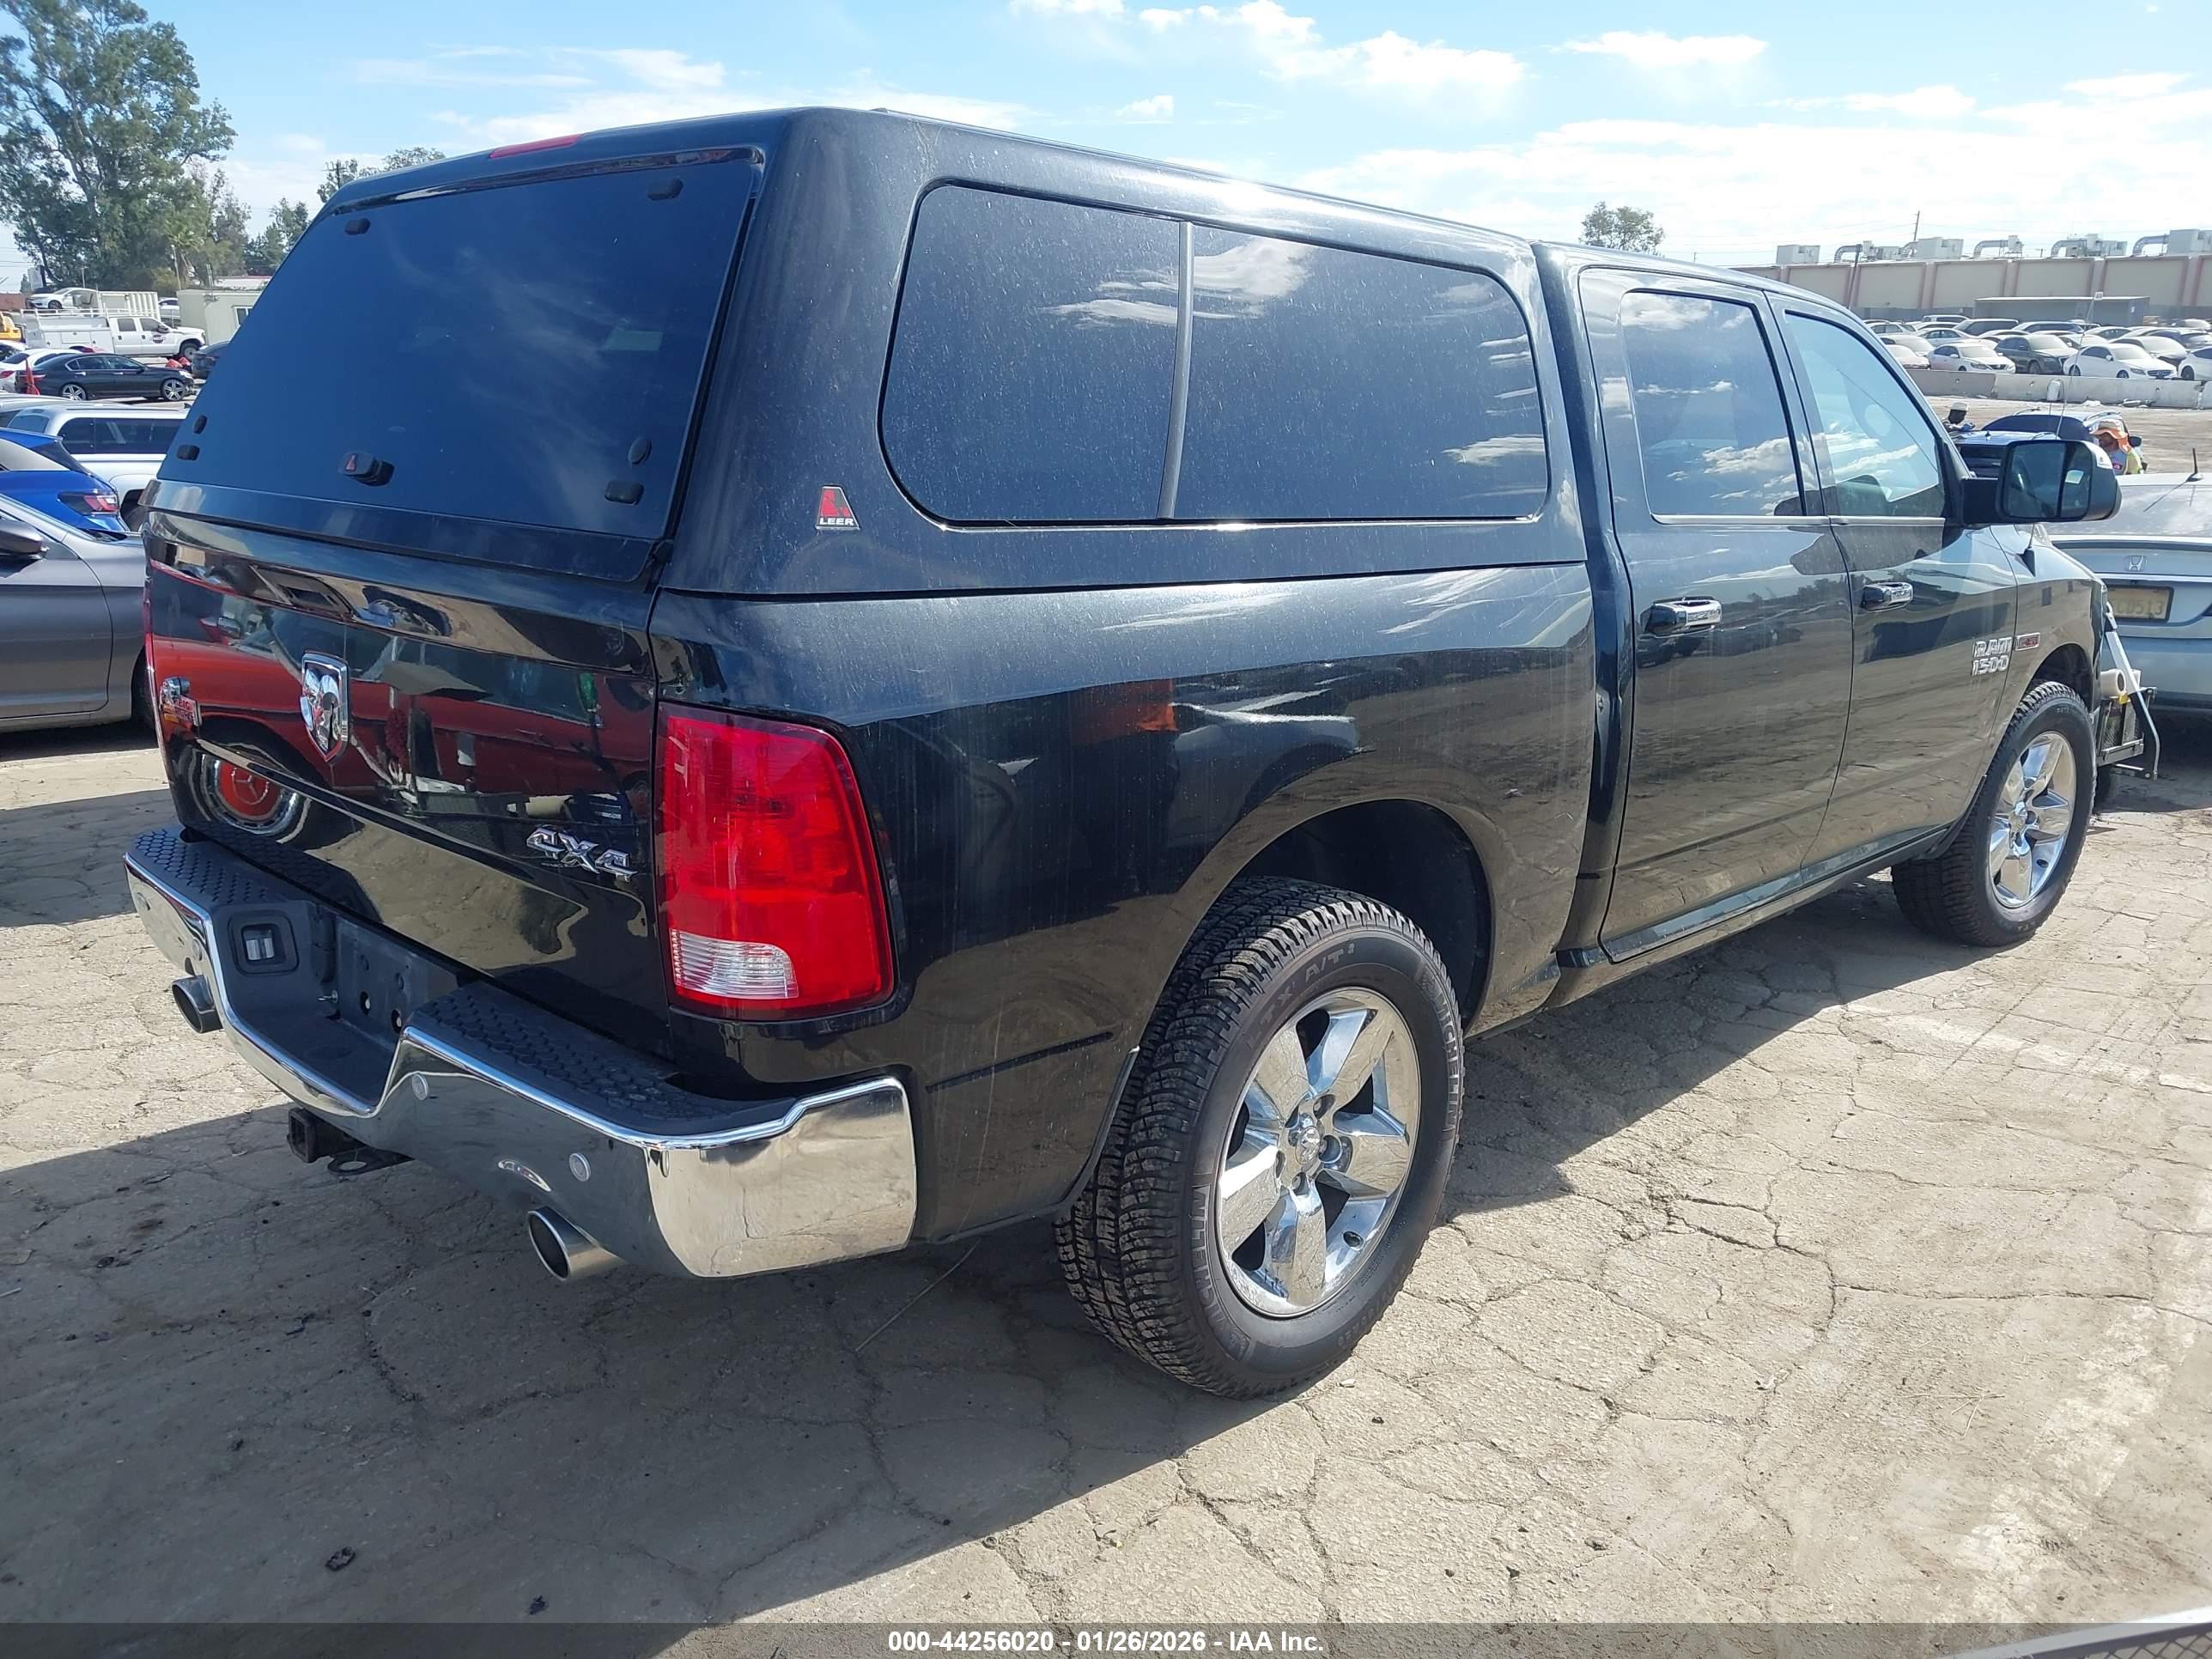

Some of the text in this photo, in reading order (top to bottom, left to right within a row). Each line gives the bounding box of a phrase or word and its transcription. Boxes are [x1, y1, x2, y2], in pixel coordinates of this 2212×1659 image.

[819, 517, 854, 526] LEER
[1973, 636, 2012, 658] RAM
[1972, 654, 2009, 676] 1500
